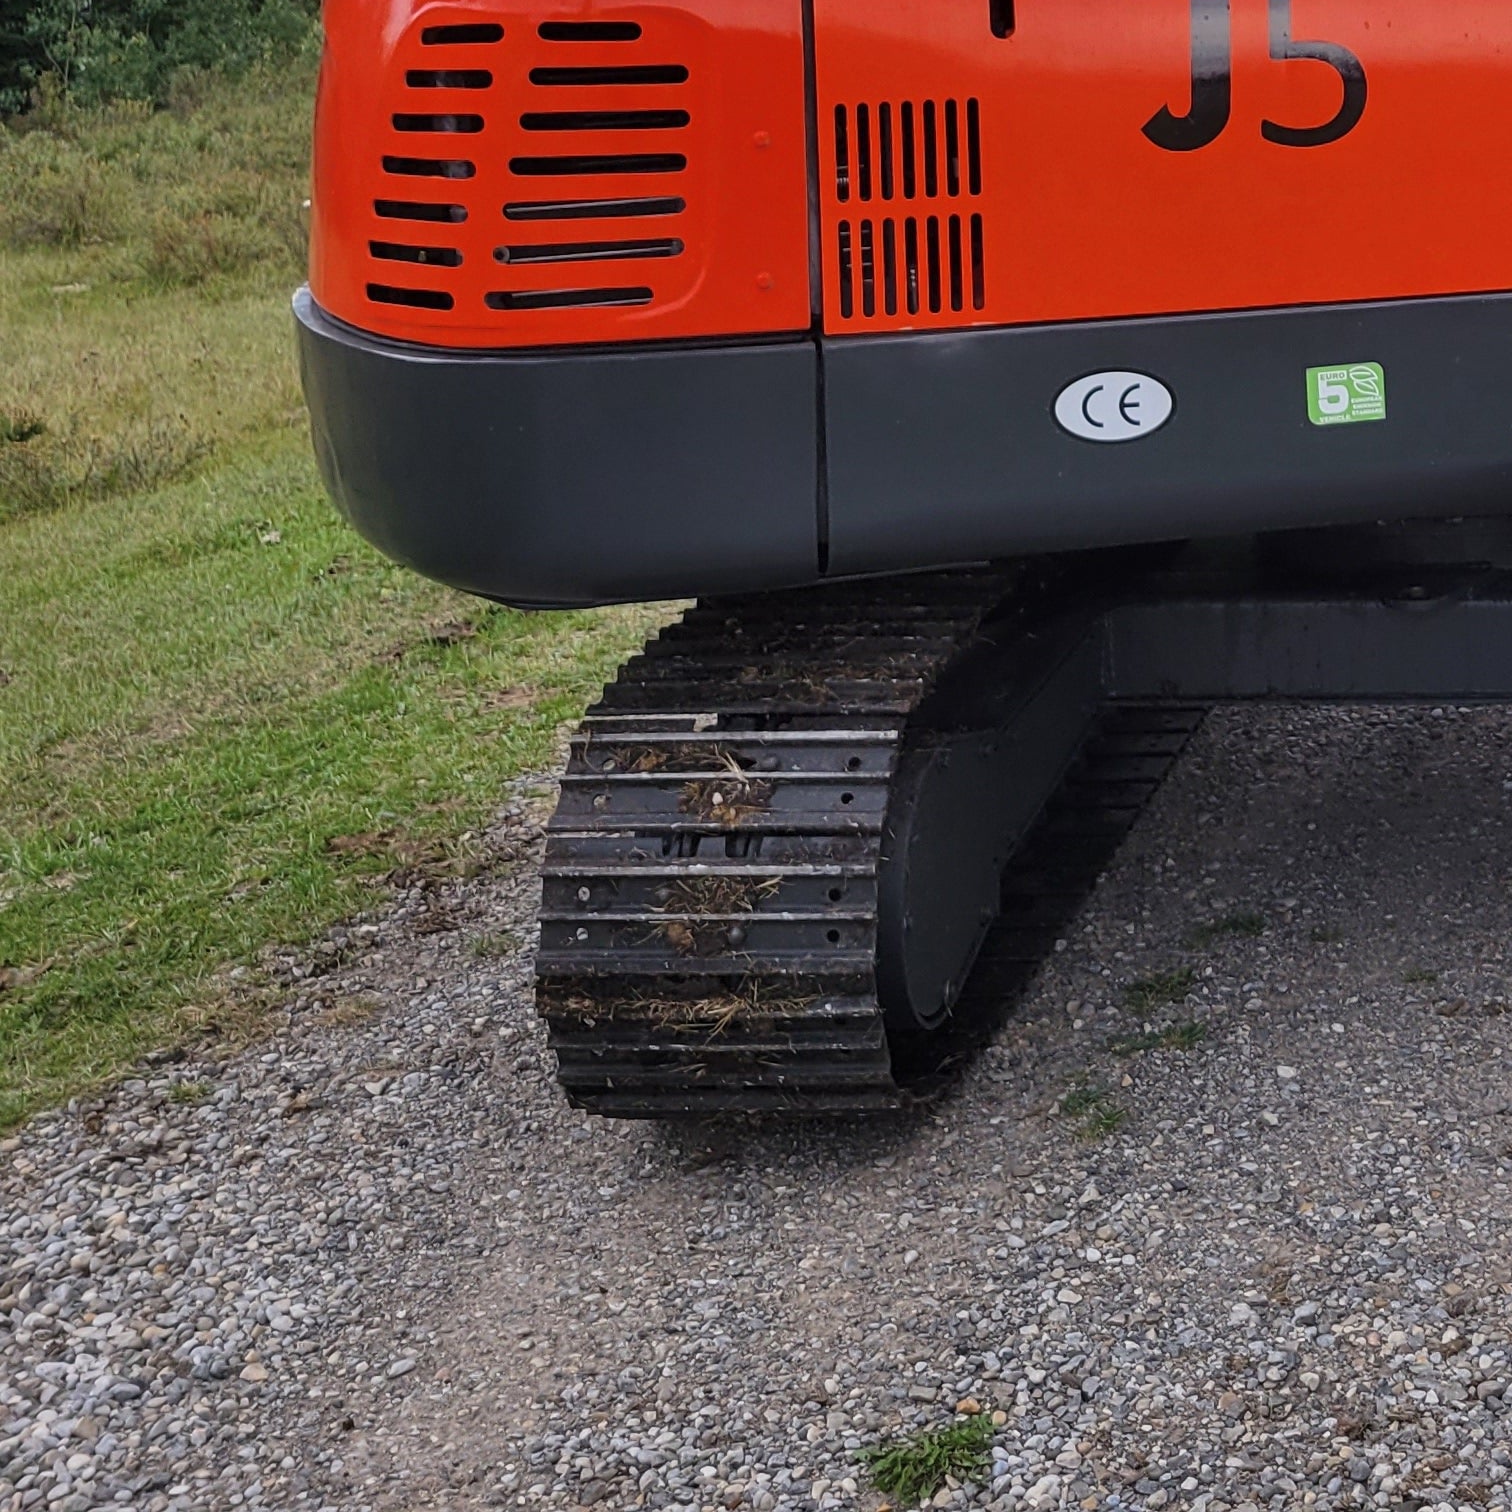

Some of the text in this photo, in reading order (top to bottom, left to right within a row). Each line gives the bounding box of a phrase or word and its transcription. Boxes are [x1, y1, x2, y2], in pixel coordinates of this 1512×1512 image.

[1320, 372, 1345, 381] EURO
[1081, 383, 1140, 428] CE
[1318, 371, 1349, 415] 5
[1319, 414, 1351, 423] VEHICLE
